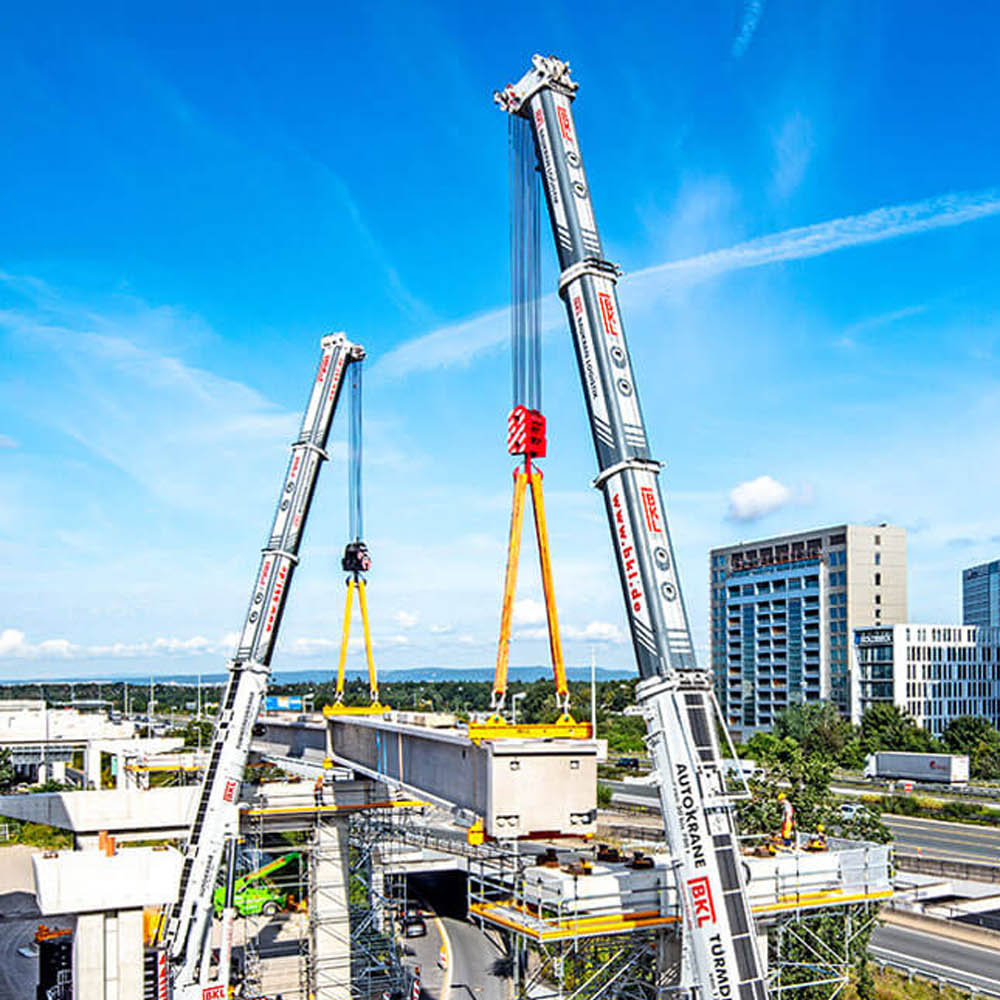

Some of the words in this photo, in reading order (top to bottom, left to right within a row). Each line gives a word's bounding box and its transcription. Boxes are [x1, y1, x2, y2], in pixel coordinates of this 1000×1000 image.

[642, 487, 661, 533] BKL
[612, 494, 641, 612] www.bkl.de
[675, 763, 706, 868] AUTOKRANE
[688, 879, 714, 928] BKL
